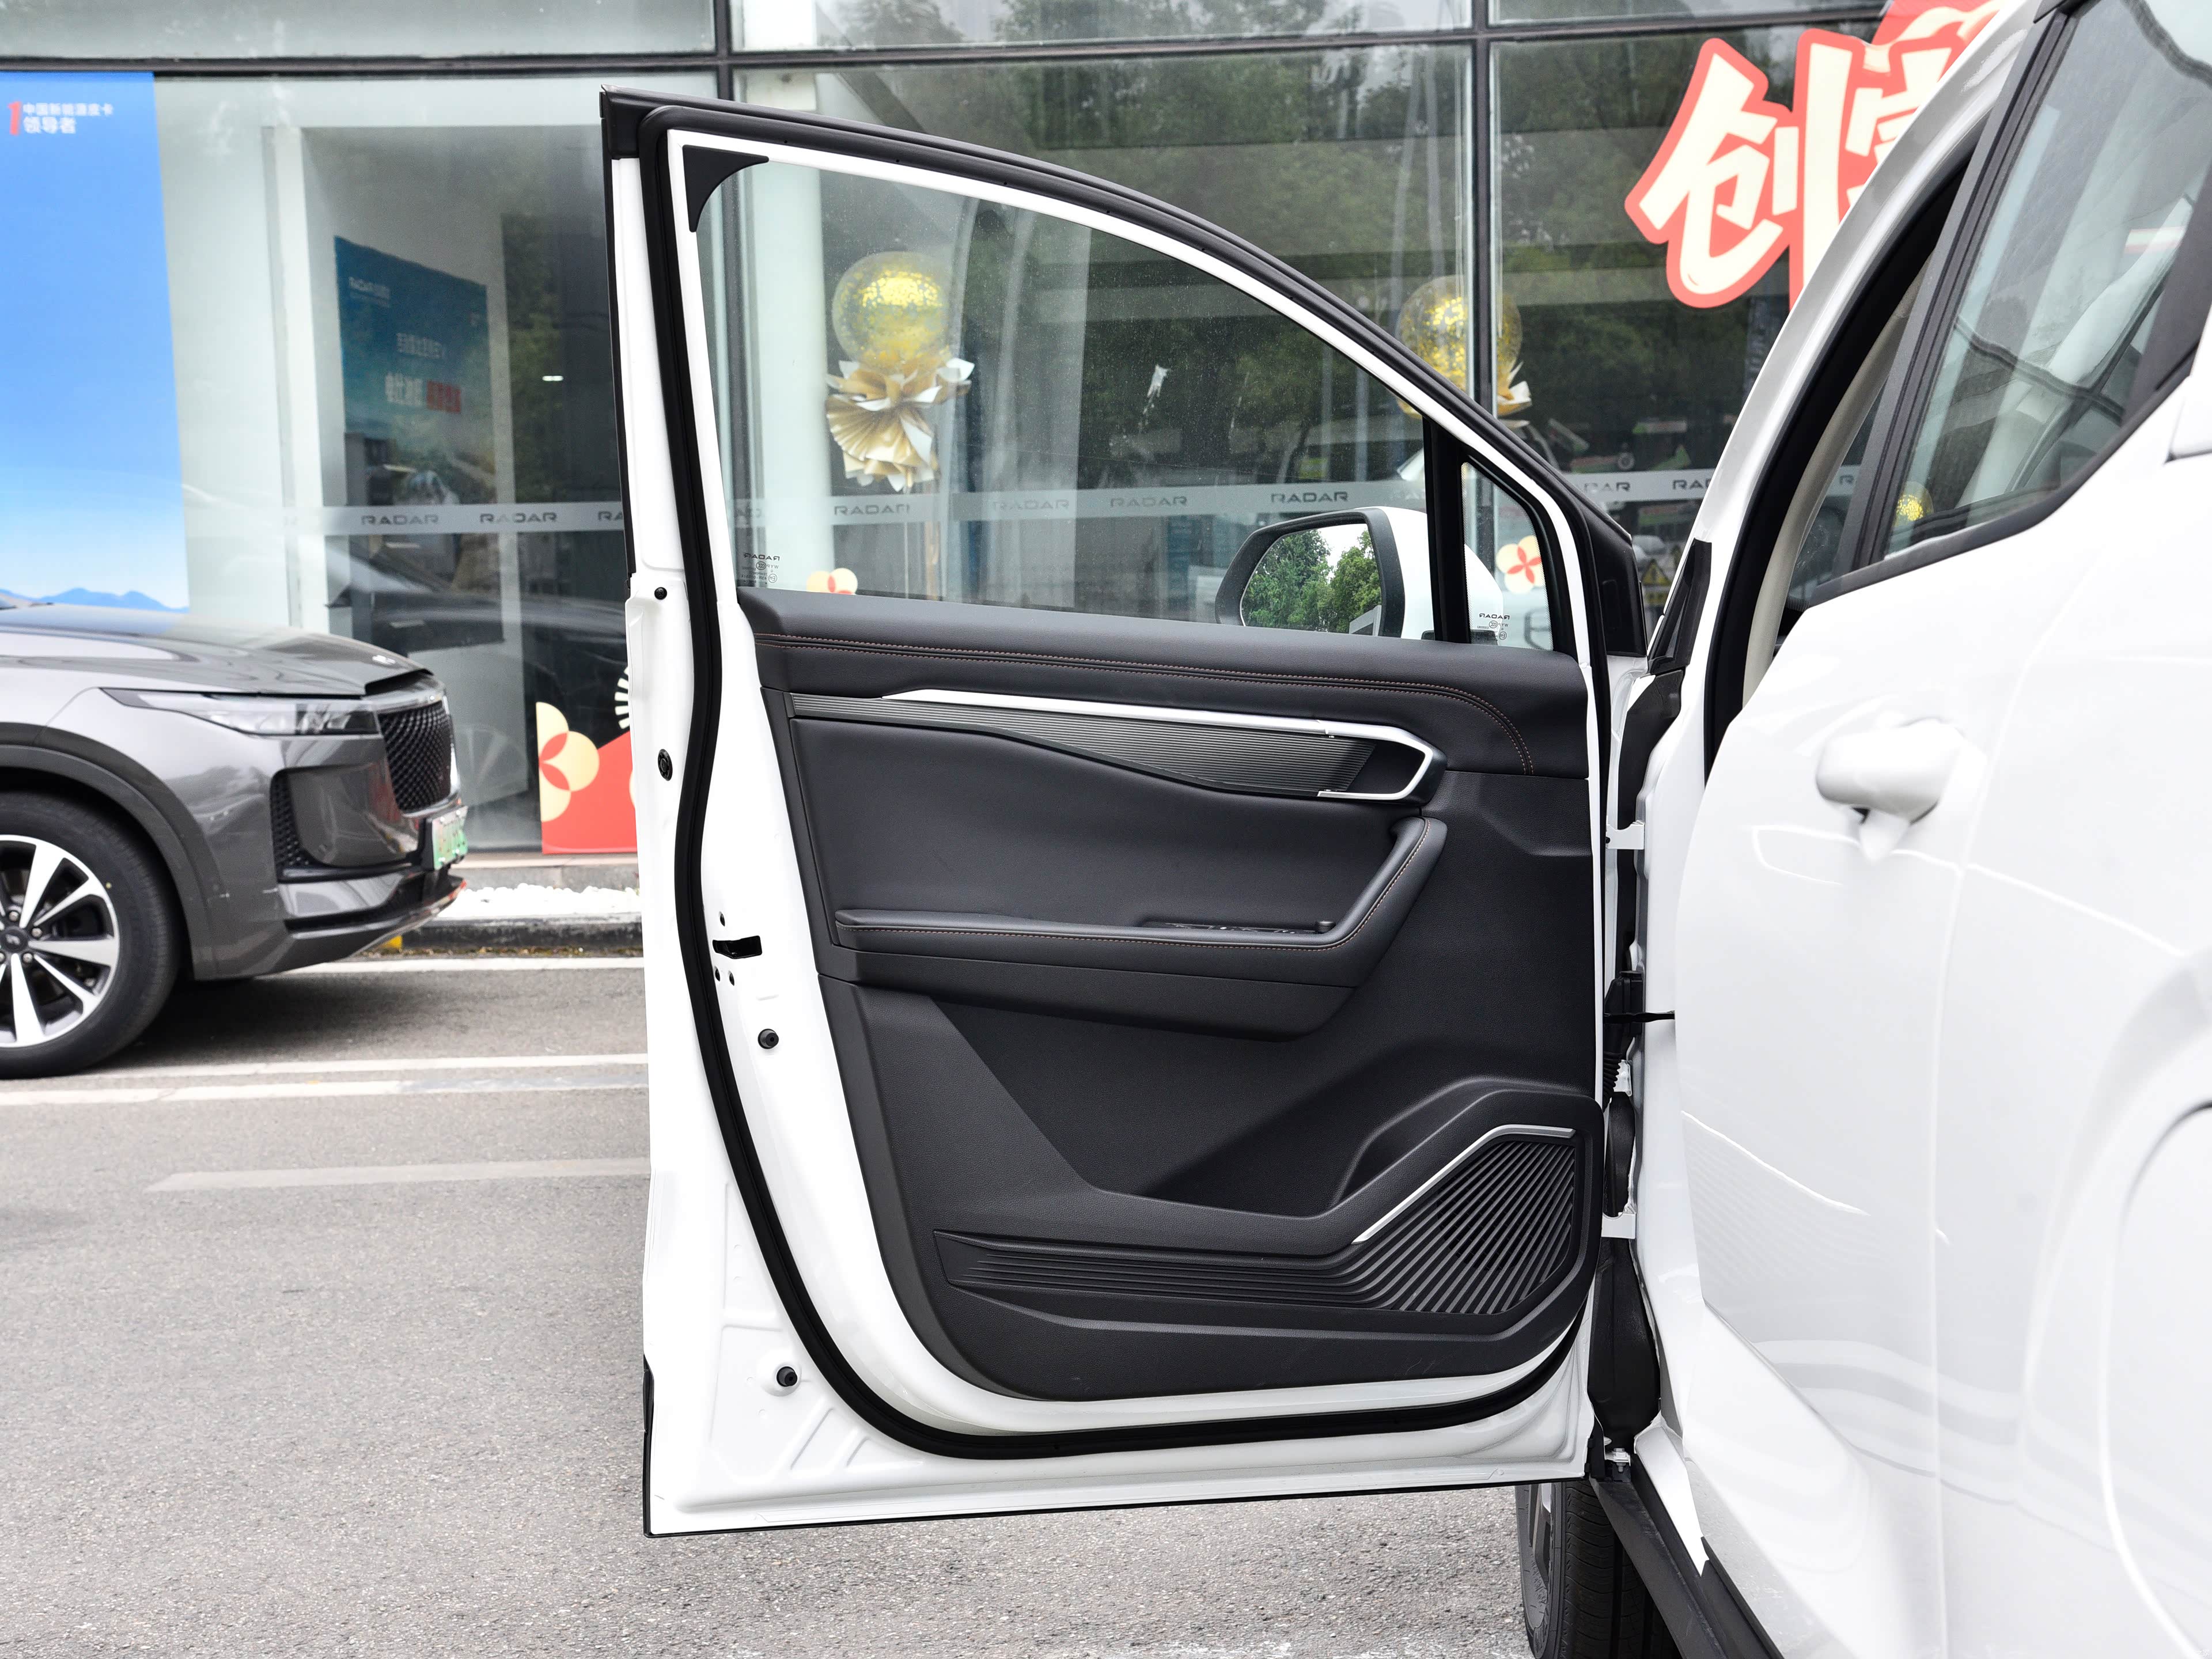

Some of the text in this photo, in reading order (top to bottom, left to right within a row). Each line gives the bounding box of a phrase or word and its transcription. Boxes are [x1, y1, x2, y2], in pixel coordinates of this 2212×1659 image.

[7, 101, 22, 136] 1
[1109, 496, 1187, 507] RADAR
[1271, 491, 1349, 503] RADAR
[361, 515, 440, 525] RADAR
[479, 512, 558, 524] RADAR
